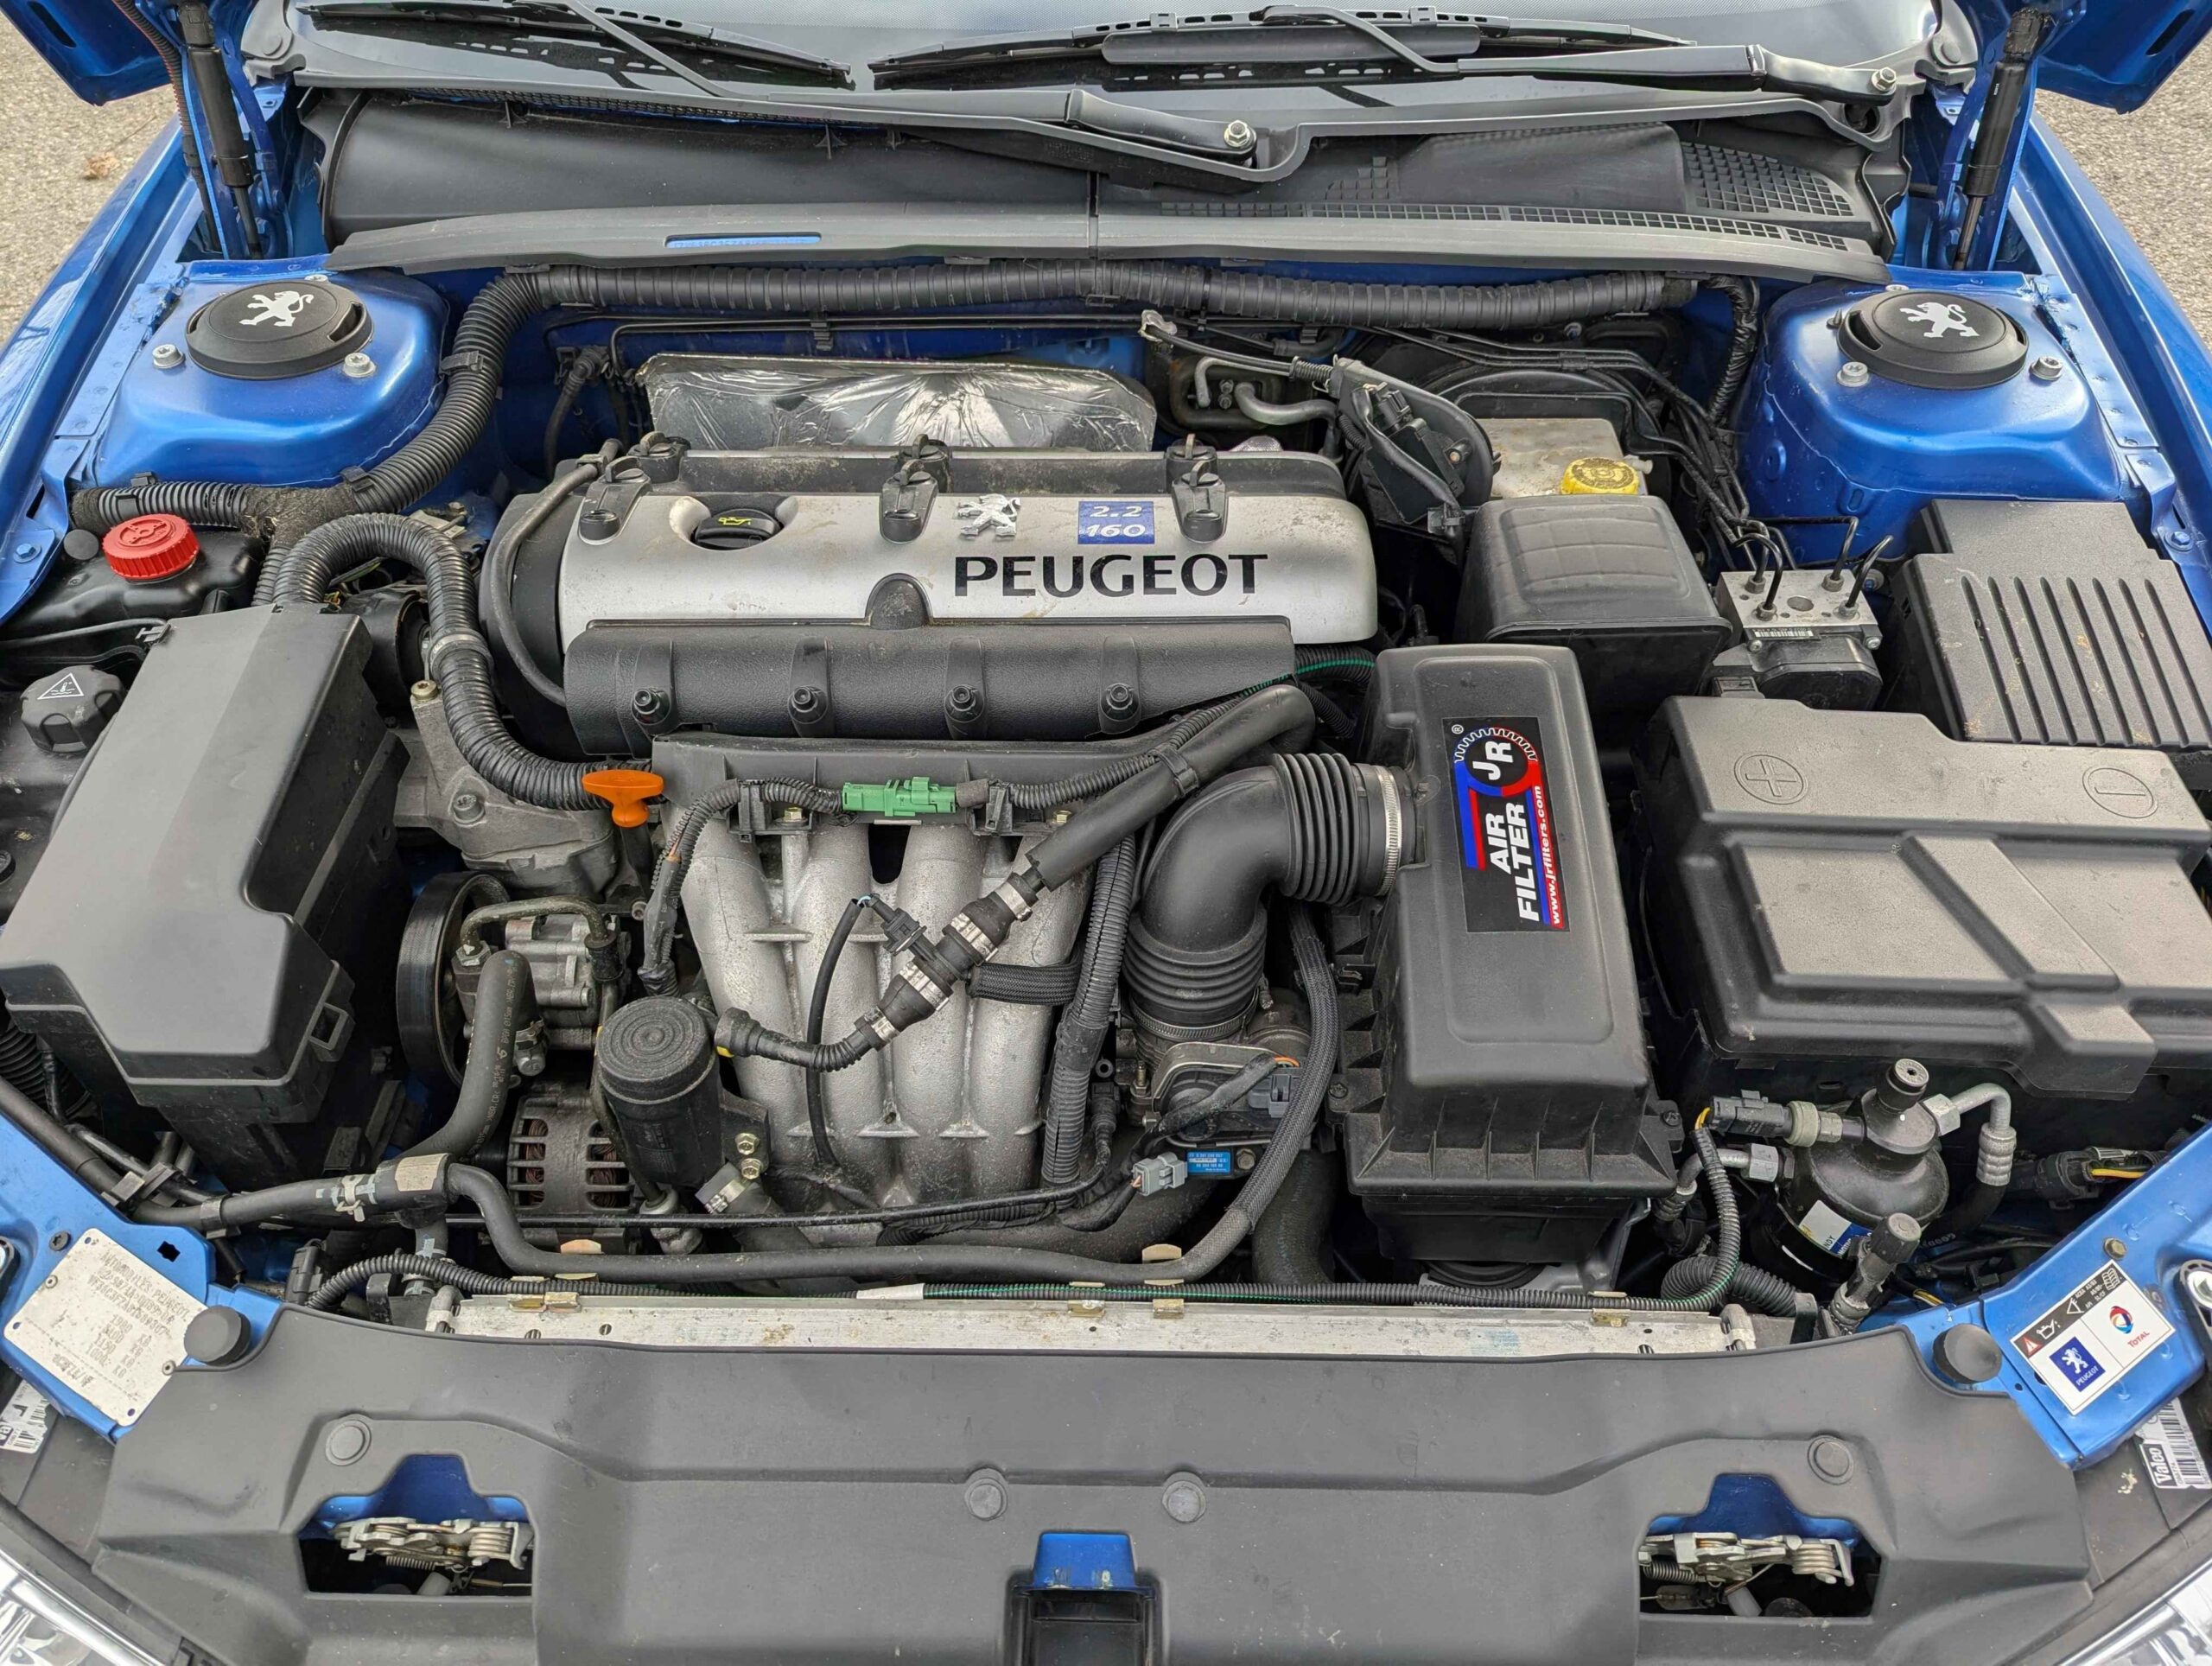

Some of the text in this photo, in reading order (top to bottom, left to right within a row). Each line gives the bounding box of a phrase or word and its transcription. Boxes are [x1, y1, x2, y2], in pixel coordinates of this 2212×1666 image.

[1086, 523, 1146, 537] 160
[1090, 505, 1142, 518] 2.2
[955, 553, 1268, 597] PEUGEOT
[1472, 741, 1514, 780] JR
[1485, 812, 1511, 874] AIR
[1534, 785, 1560, 925] www.jrfilters.com
[1505, 802, 1540, 922] FILTER
[152, 1288, 190, 1322] PEUGEOT
[2127, 1331, 2150, 1348] TOTAL
[2076, 1365, 2099, 1386] PEUGEOT
[2149, 1447, 2173, 1484] Valeo
